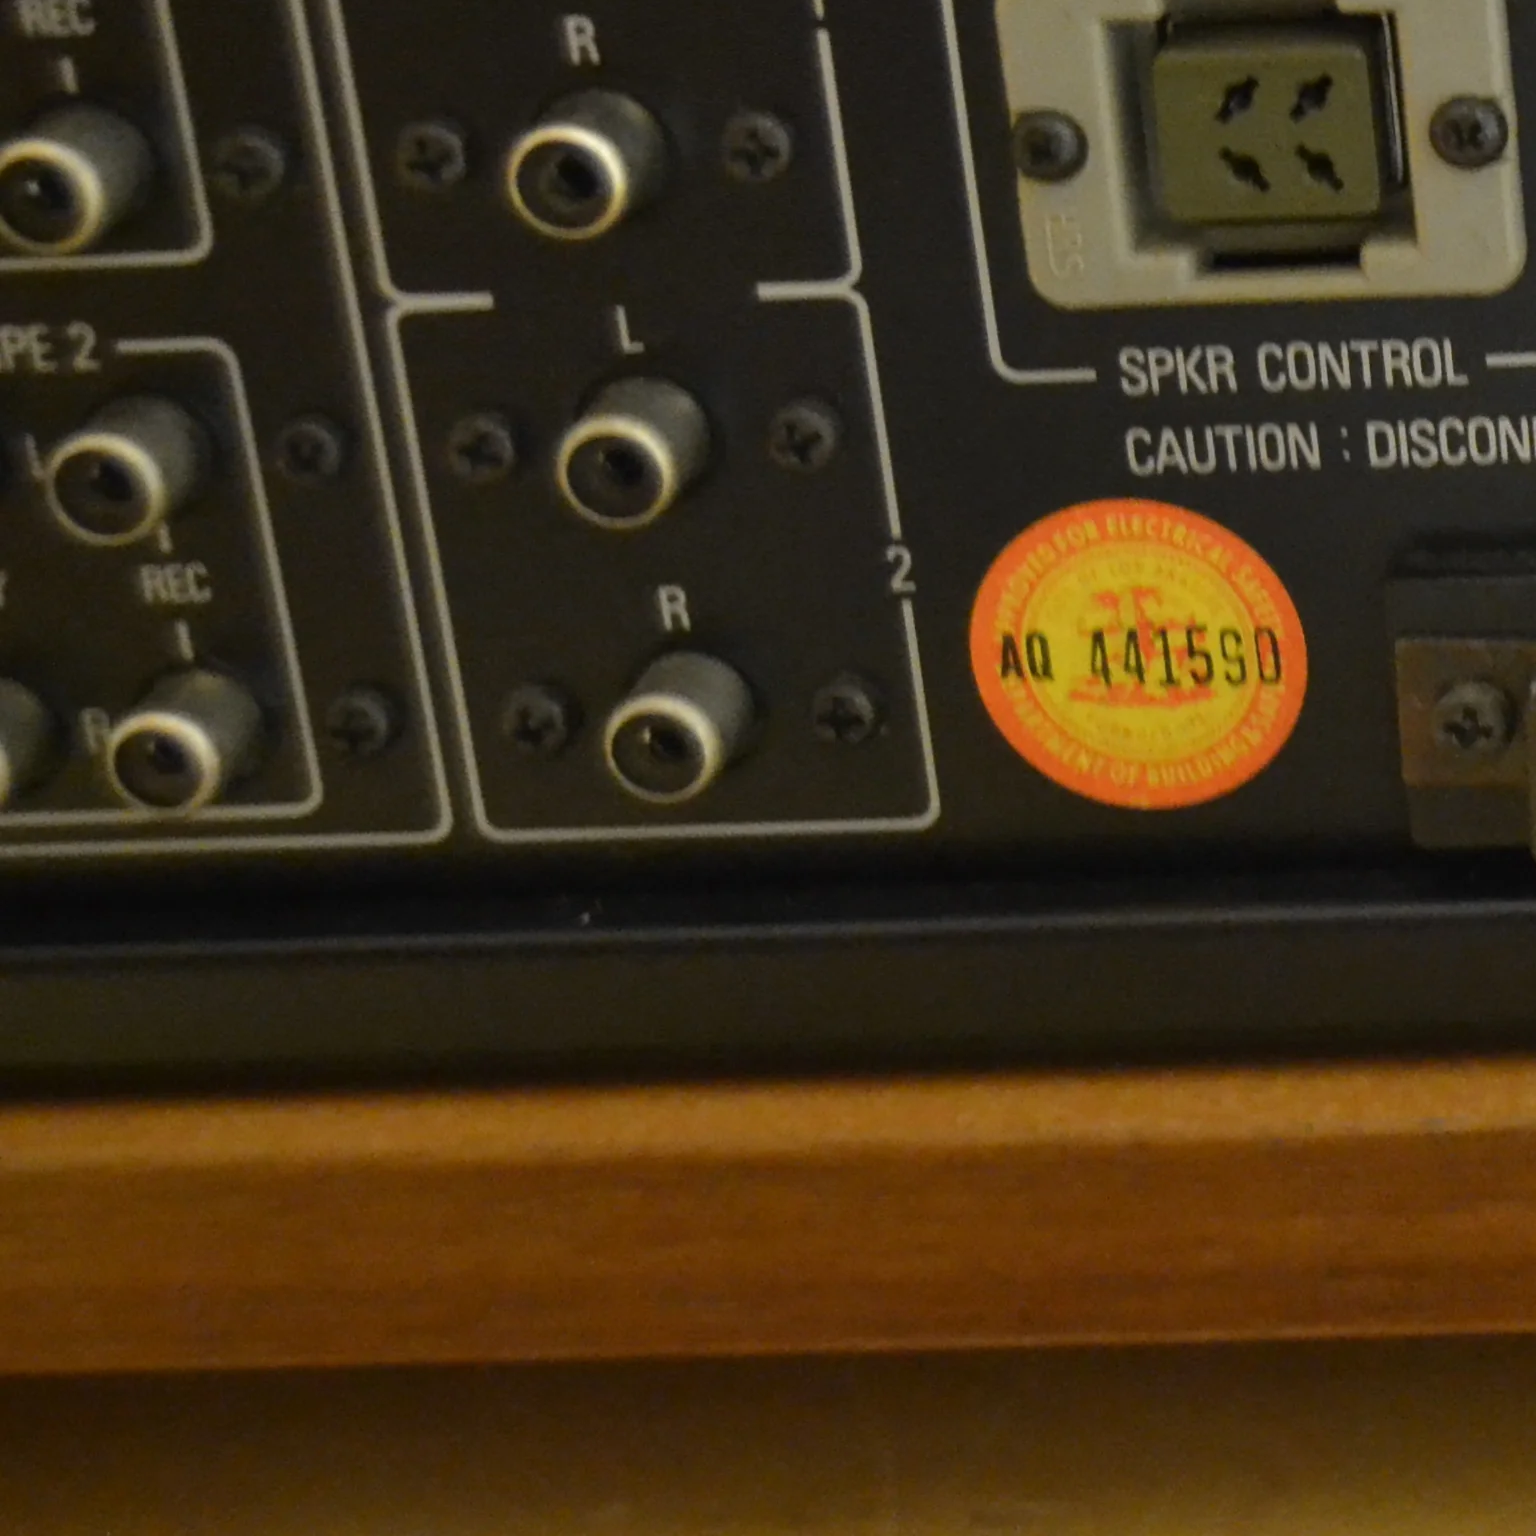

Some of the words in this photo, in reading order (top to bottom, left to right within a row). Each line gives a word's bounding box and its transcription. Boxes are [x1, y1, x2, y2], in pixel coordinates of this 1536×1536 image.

[563, 14, 600, 65] R
[66, 320, 101, 373] 2
[614, 305, 644, 354] L
[1118, 344, 1238, 396] SPKR
[1256, 337, 1469, 392] CONTROL
[139, 561, 212, 605] REC
[886, 545, 916, 594] 2
[657, 585, 691, 631] R
[1000, 631, 1054, 682] AQ
